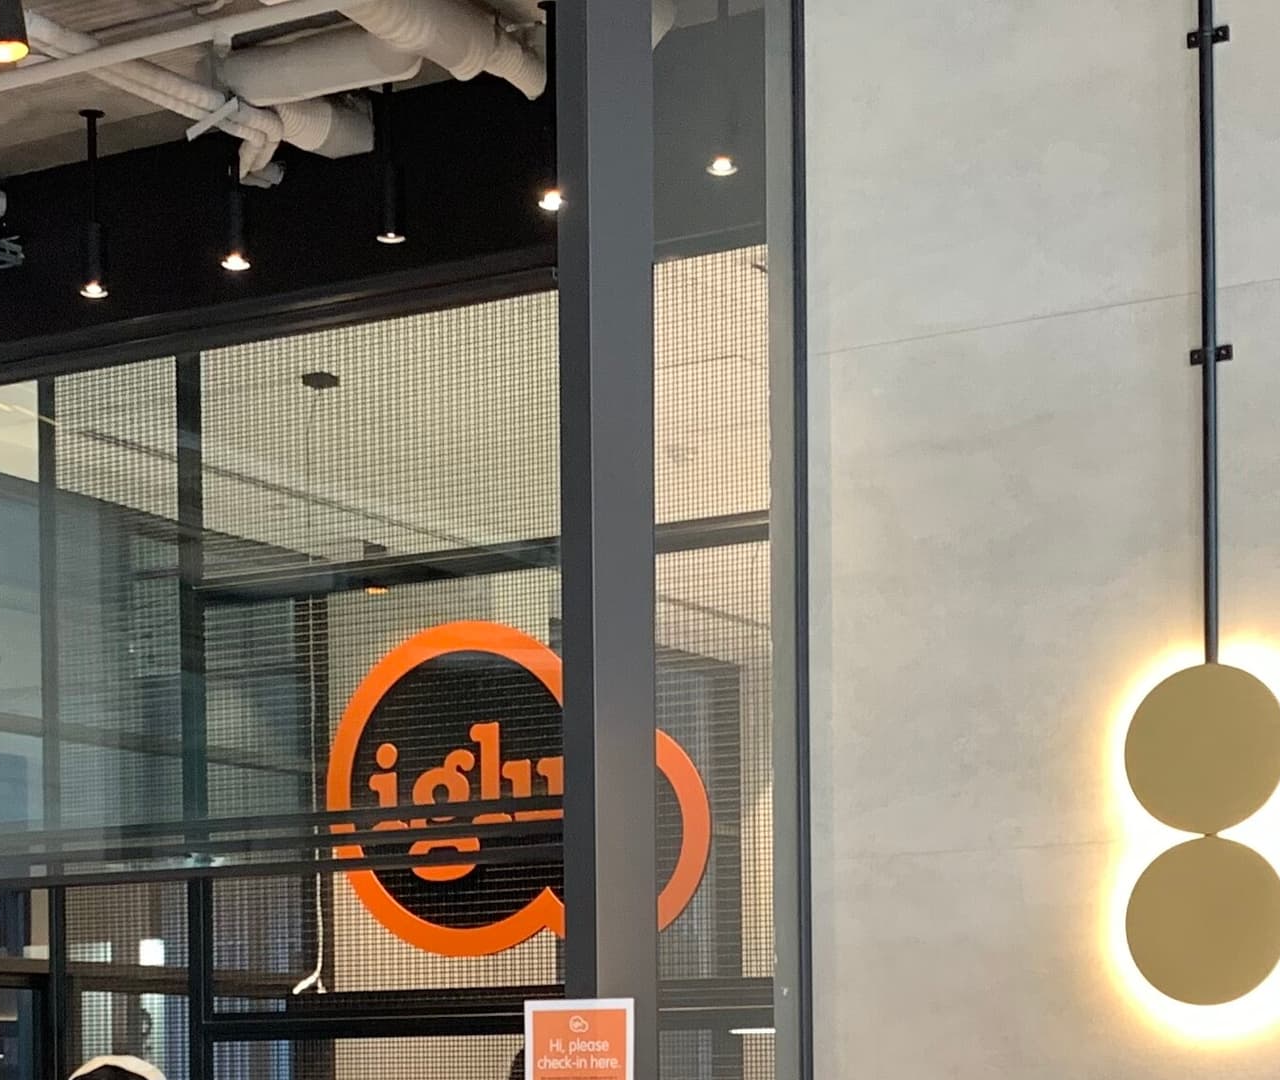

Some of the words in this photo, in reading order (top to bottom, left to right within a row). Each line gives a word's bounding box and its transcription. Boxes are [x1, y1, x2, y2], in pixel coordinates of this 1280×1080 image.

[548, 1038, 565, 1053] Hi,
[569, 1037, 609, 1055] please
[537, 1055, 587, 1069] check-in
